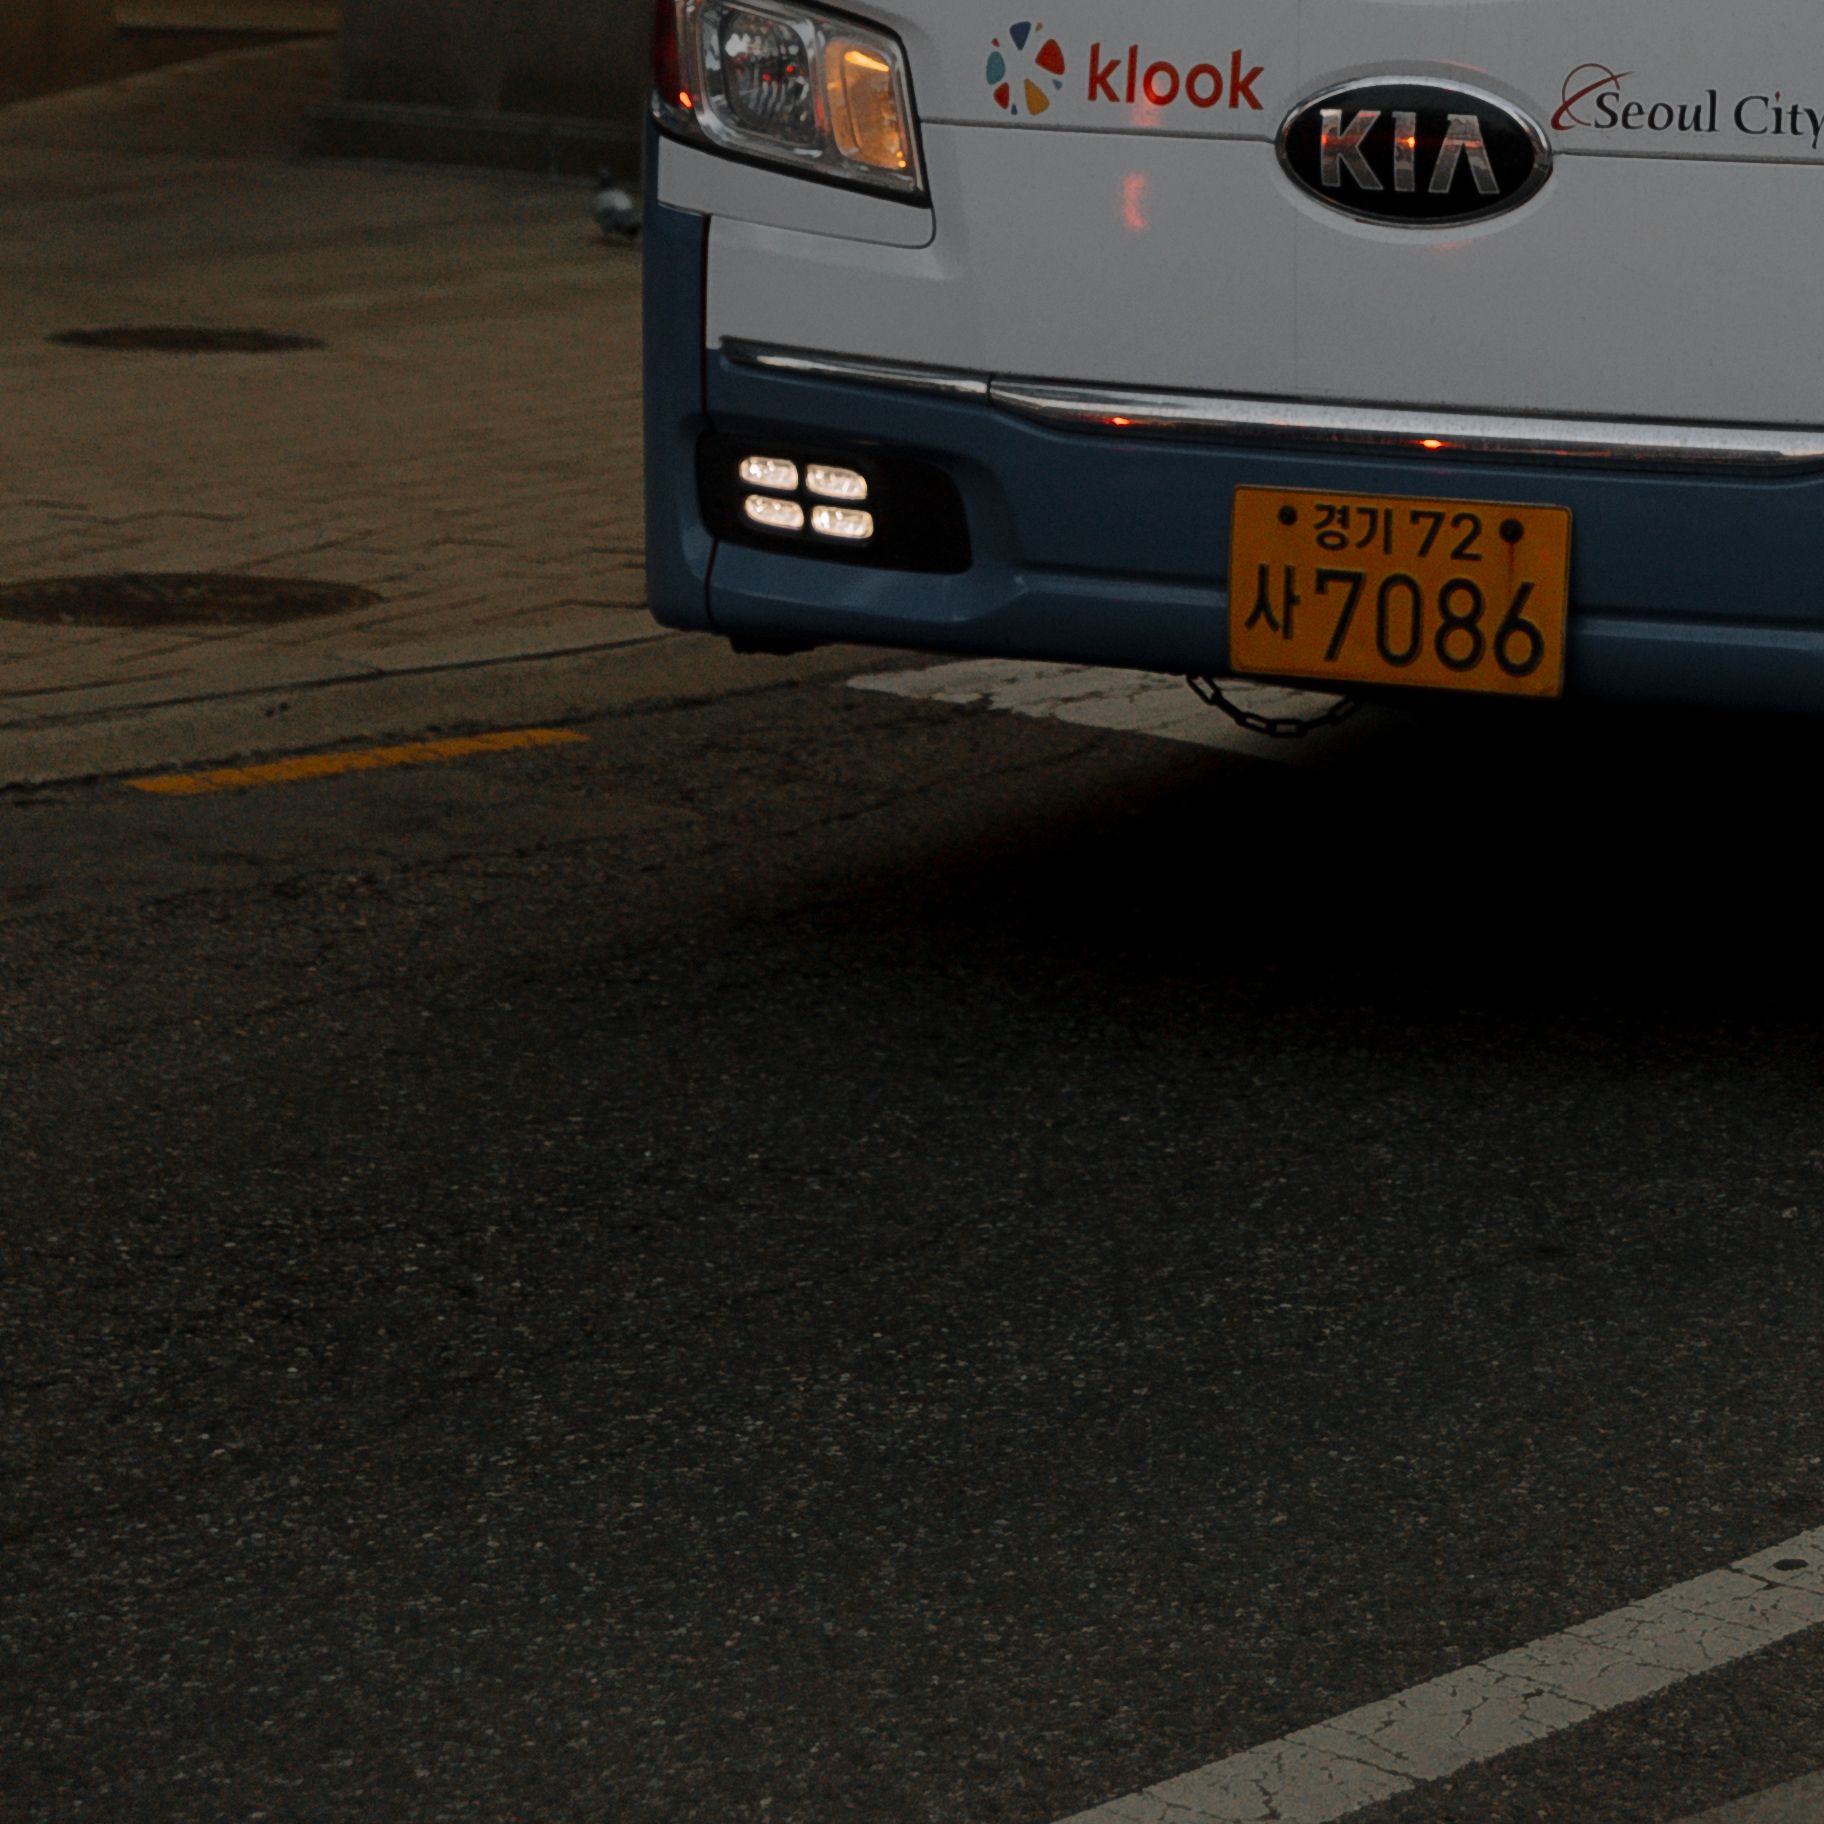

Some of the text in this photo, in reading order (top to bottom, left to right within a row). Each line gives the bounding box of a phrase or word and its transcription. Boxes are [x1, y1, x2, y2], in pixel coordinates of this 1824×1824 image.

[1088, 42, 1264, 110] klook
[1594, 89, 1717, 134] Seoul
[1319, 108, 1500, 195] KIA
